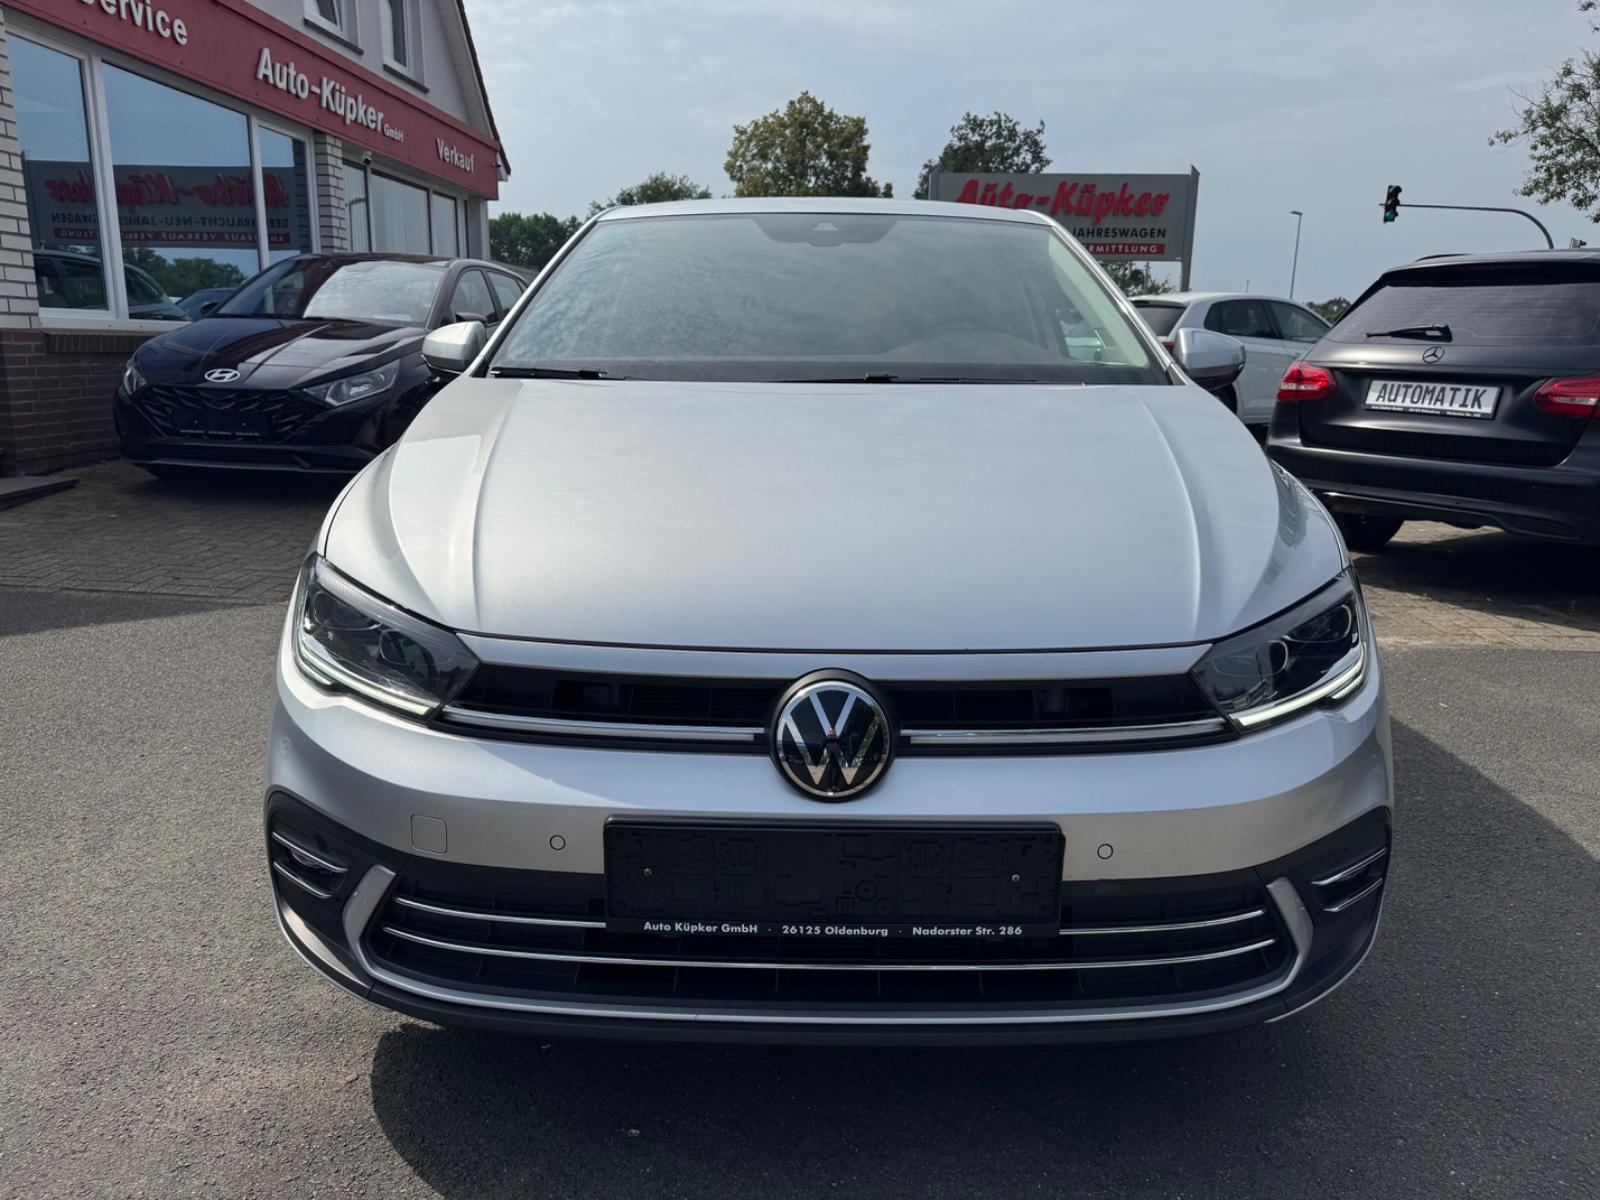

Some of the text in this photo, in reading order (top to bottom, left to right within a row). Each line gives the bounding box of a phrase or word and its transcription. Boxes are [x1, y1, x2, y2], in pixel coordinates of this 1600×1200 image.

[80, 0, 188, 46] ervice
[256, 47, 404, 143] Auto-Küpker GmbH
[435, 137, 475, 173] Verkauf
[1375, 382, 1487, 410] AUTOMATIK
[643, 921, 1023, 937] Auto Küpker GmbH 26125 Oldenburg Nadorster Str. 286
